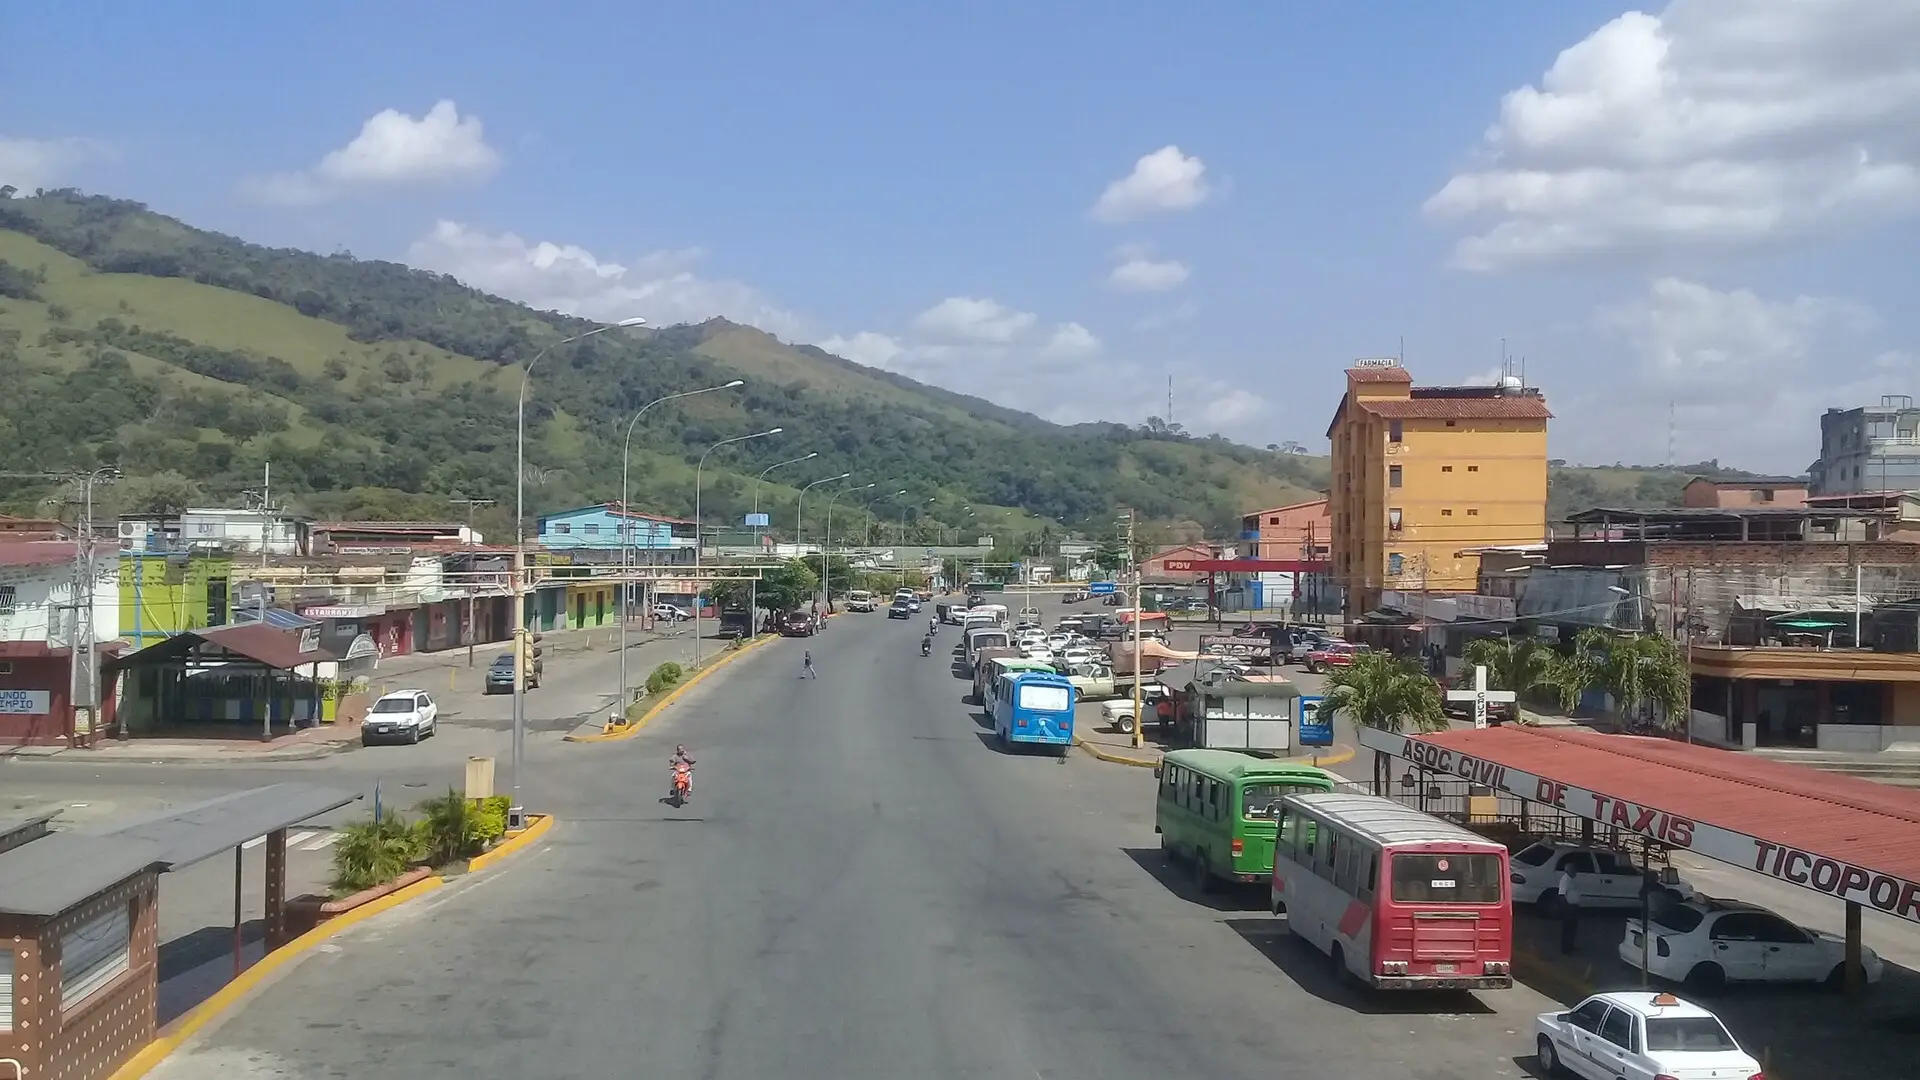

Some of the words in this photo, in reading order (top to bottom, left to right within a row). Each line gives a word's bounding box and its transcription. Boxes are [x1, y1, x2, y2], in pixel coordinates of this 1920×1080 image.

[1360, 359, 1392, 367] FARMACIA
[1169, 561, 1191, 570] PDV
[1477, 691, 1485, 718] CRUZ
[1458, 755, 1511, 791] CIVIL
[1536, 778, 1568, 809] DE
[1591, 793, 1695, 848] TAXIS
[1754, 839, 1920, 919] TICOPOR
